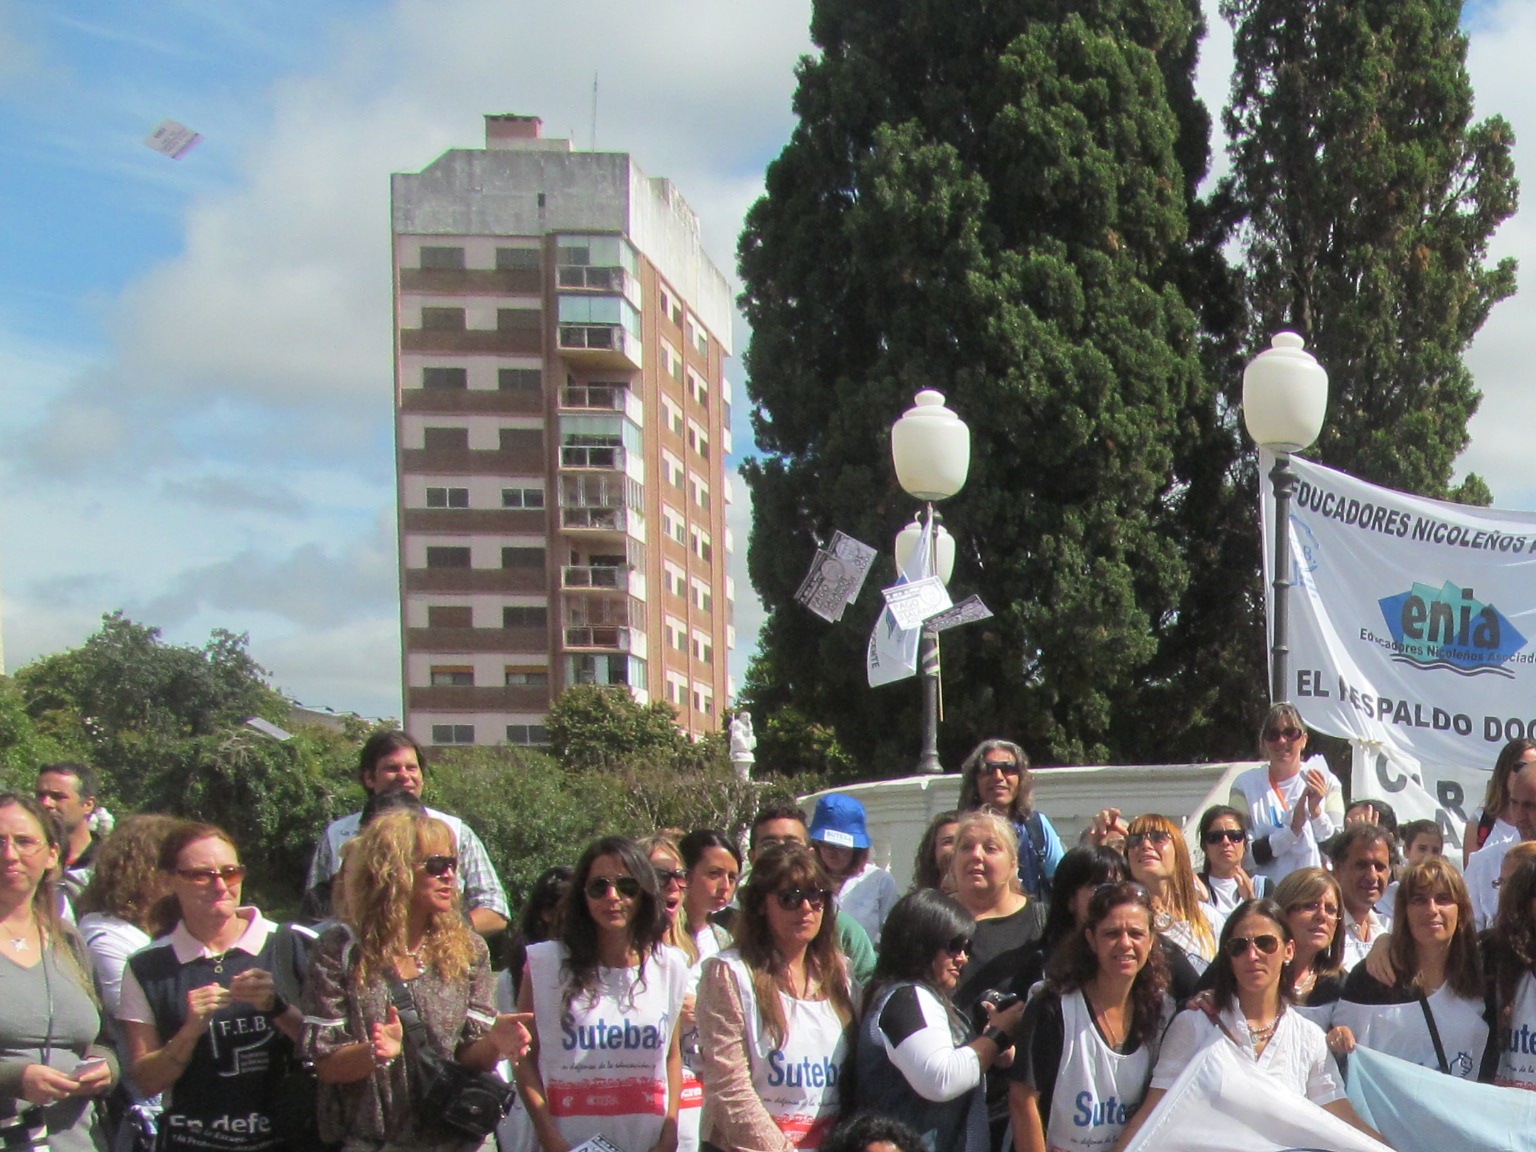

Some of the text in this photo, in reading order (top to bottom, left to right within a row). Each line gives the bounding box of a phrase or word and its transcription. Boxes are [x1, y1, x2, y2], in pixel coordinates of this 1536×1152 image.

[1411, 517, 1526, 553] NICOLEÑOS
[1402, 588, 1500, 650] enia
[1296, 669, 1330, 699] EL
[219, 1015, 272, 1037] F.E.B.
[561, 1011, 658, 1051] Suteba
[767, 1050, 839, 1087] Suteb
[211, 1112, 272, 1134] defe
[1073, 1091, 1127, 1127] Sute
